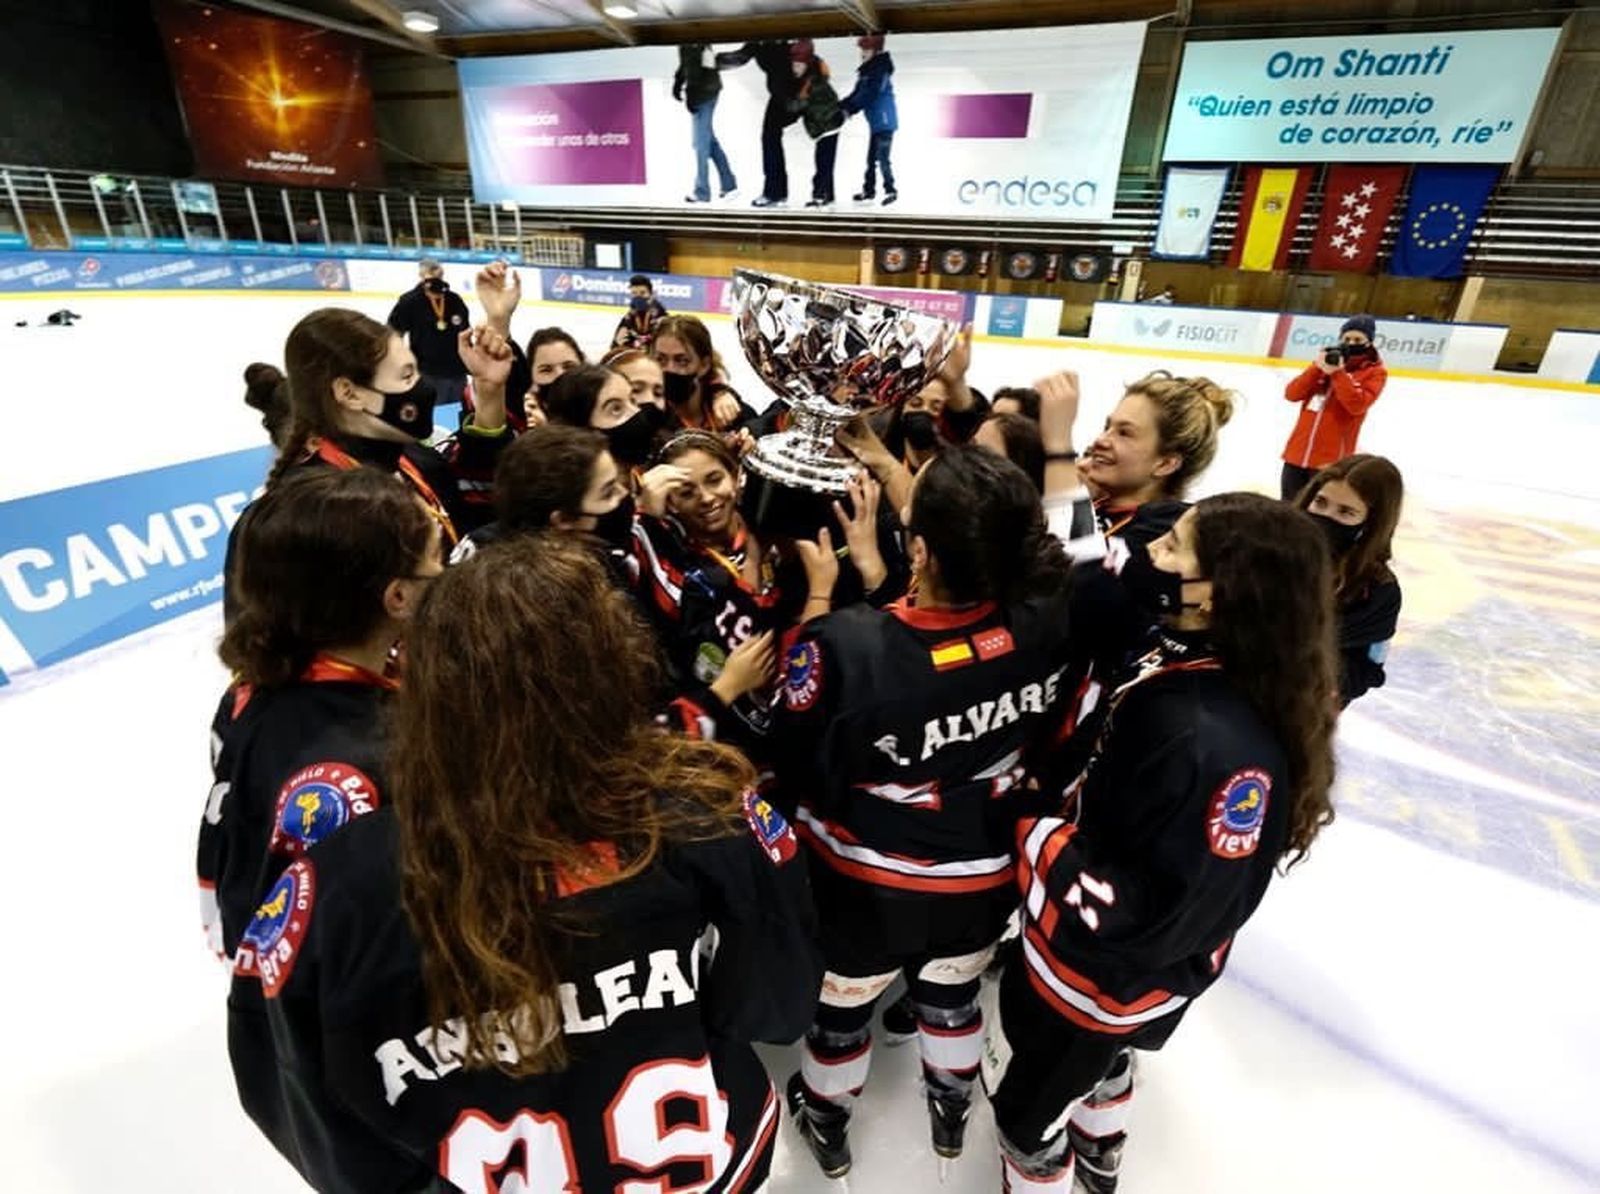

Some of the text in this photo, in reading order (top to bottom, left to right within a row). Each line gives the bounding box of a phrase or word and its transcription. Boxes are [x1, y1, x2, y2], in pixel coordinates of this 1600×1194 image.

[1266, 45, 1454, 79] Om Shanti
[1279, 92, 1340, 116] está
[1345, 92, 1434, 119] limpio
[1279, 122, 1313, 143] de
[1321, 120, 1441, 148] corazón,
[957, 175, 1098, 207] endesa
[920, 663, 1070, 762] ALVARE
